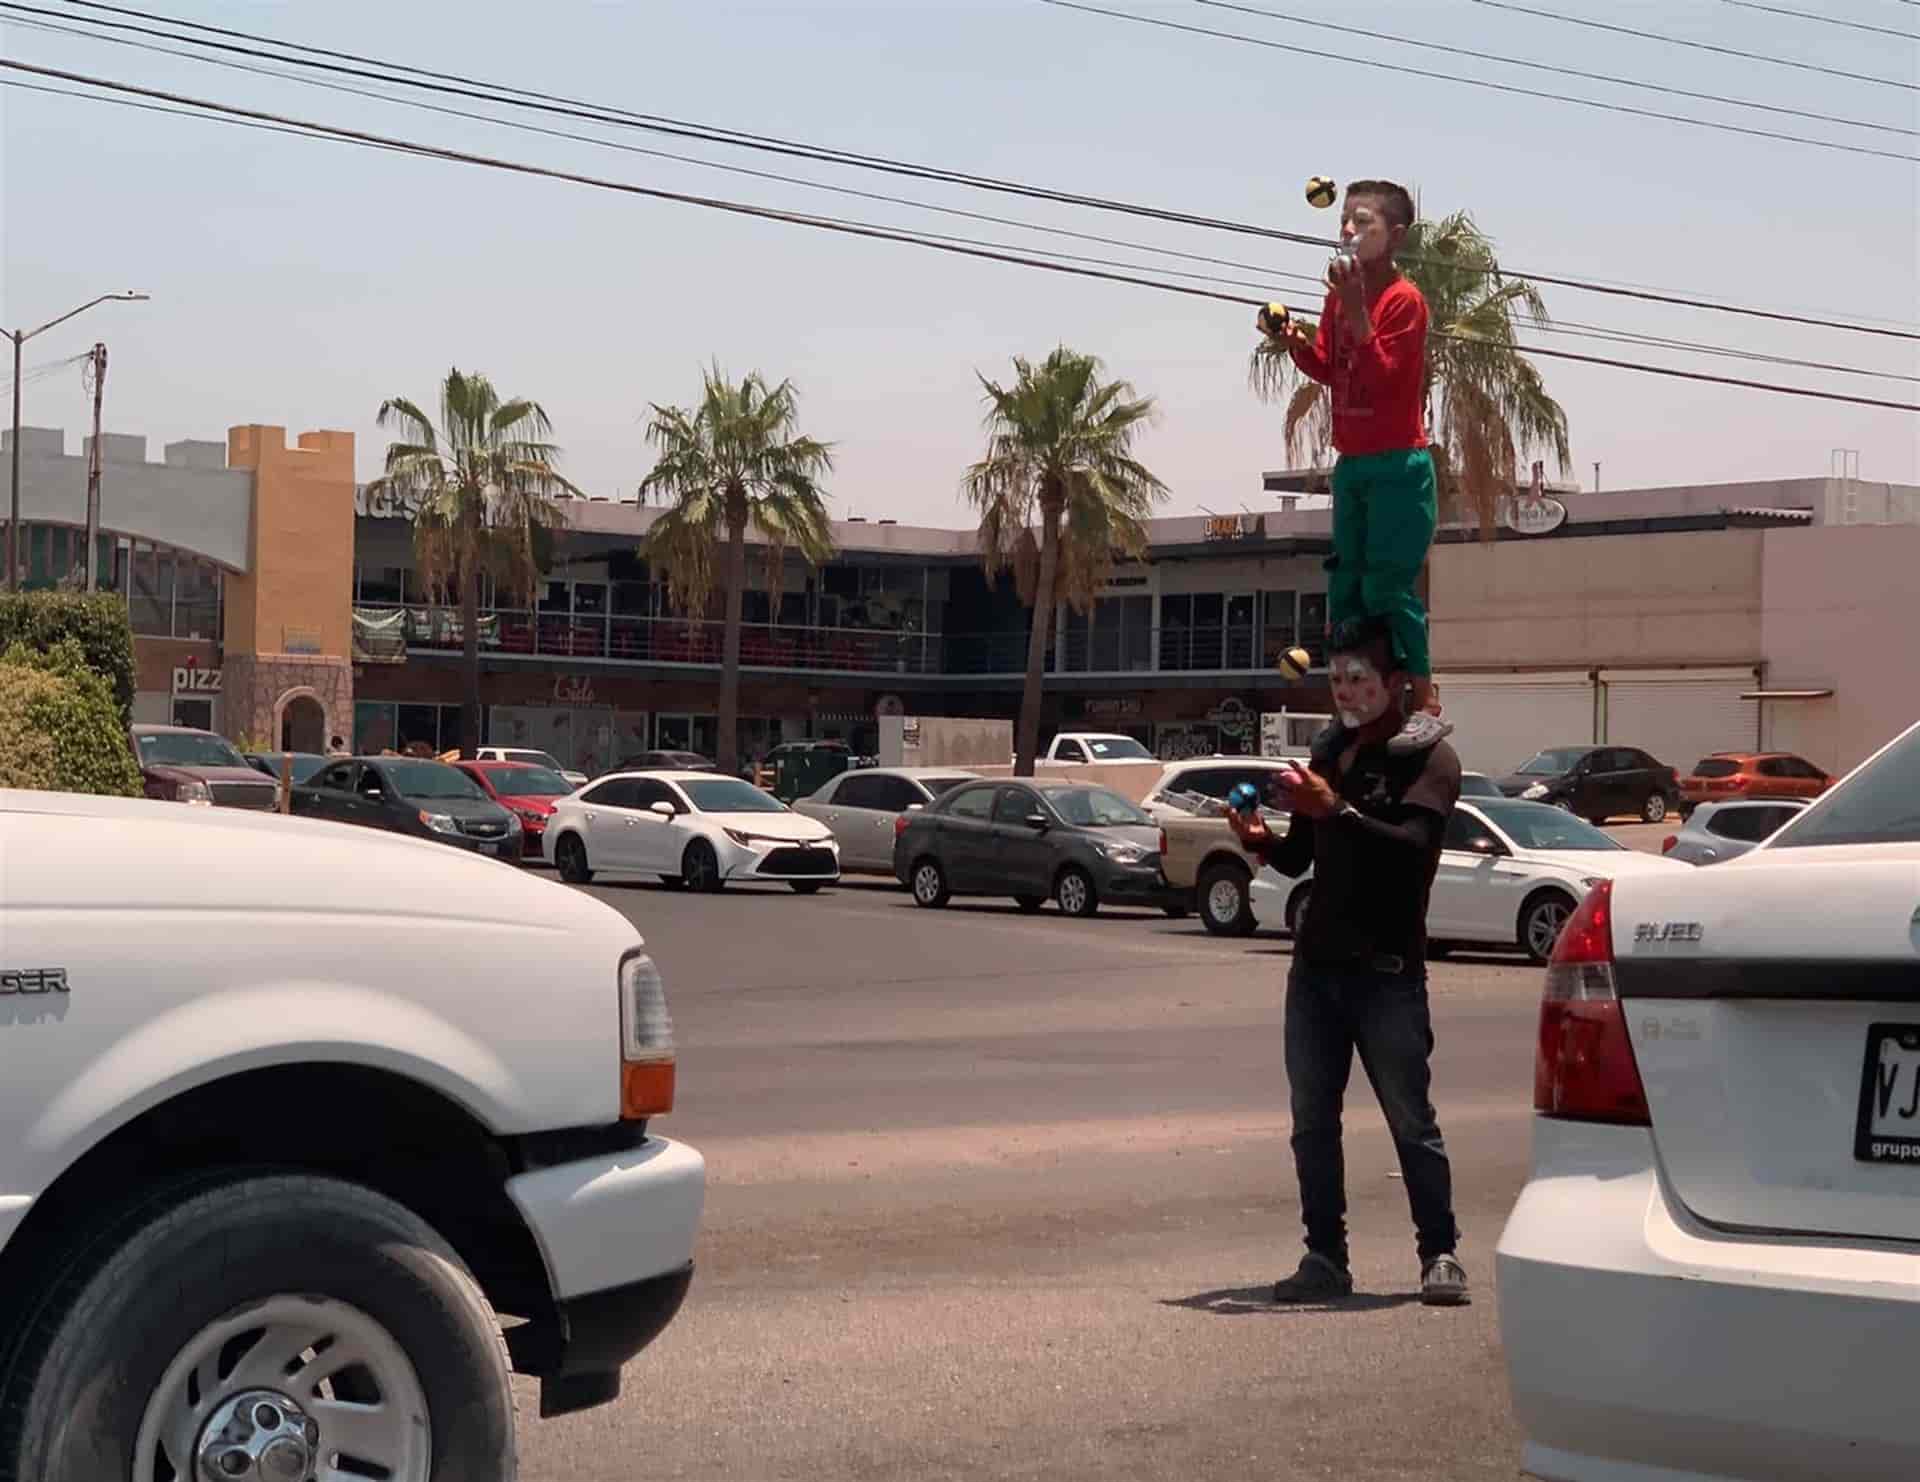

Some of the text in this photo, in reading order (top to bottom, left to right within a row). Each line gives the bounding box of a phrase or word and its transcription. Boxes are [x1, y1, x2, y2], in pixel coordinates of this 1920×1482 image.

[0, 967, 71, 994] GER
[1878, 1061, 1920, 1119] VJ
[1871, 1142, 1920, 1159] grupo
